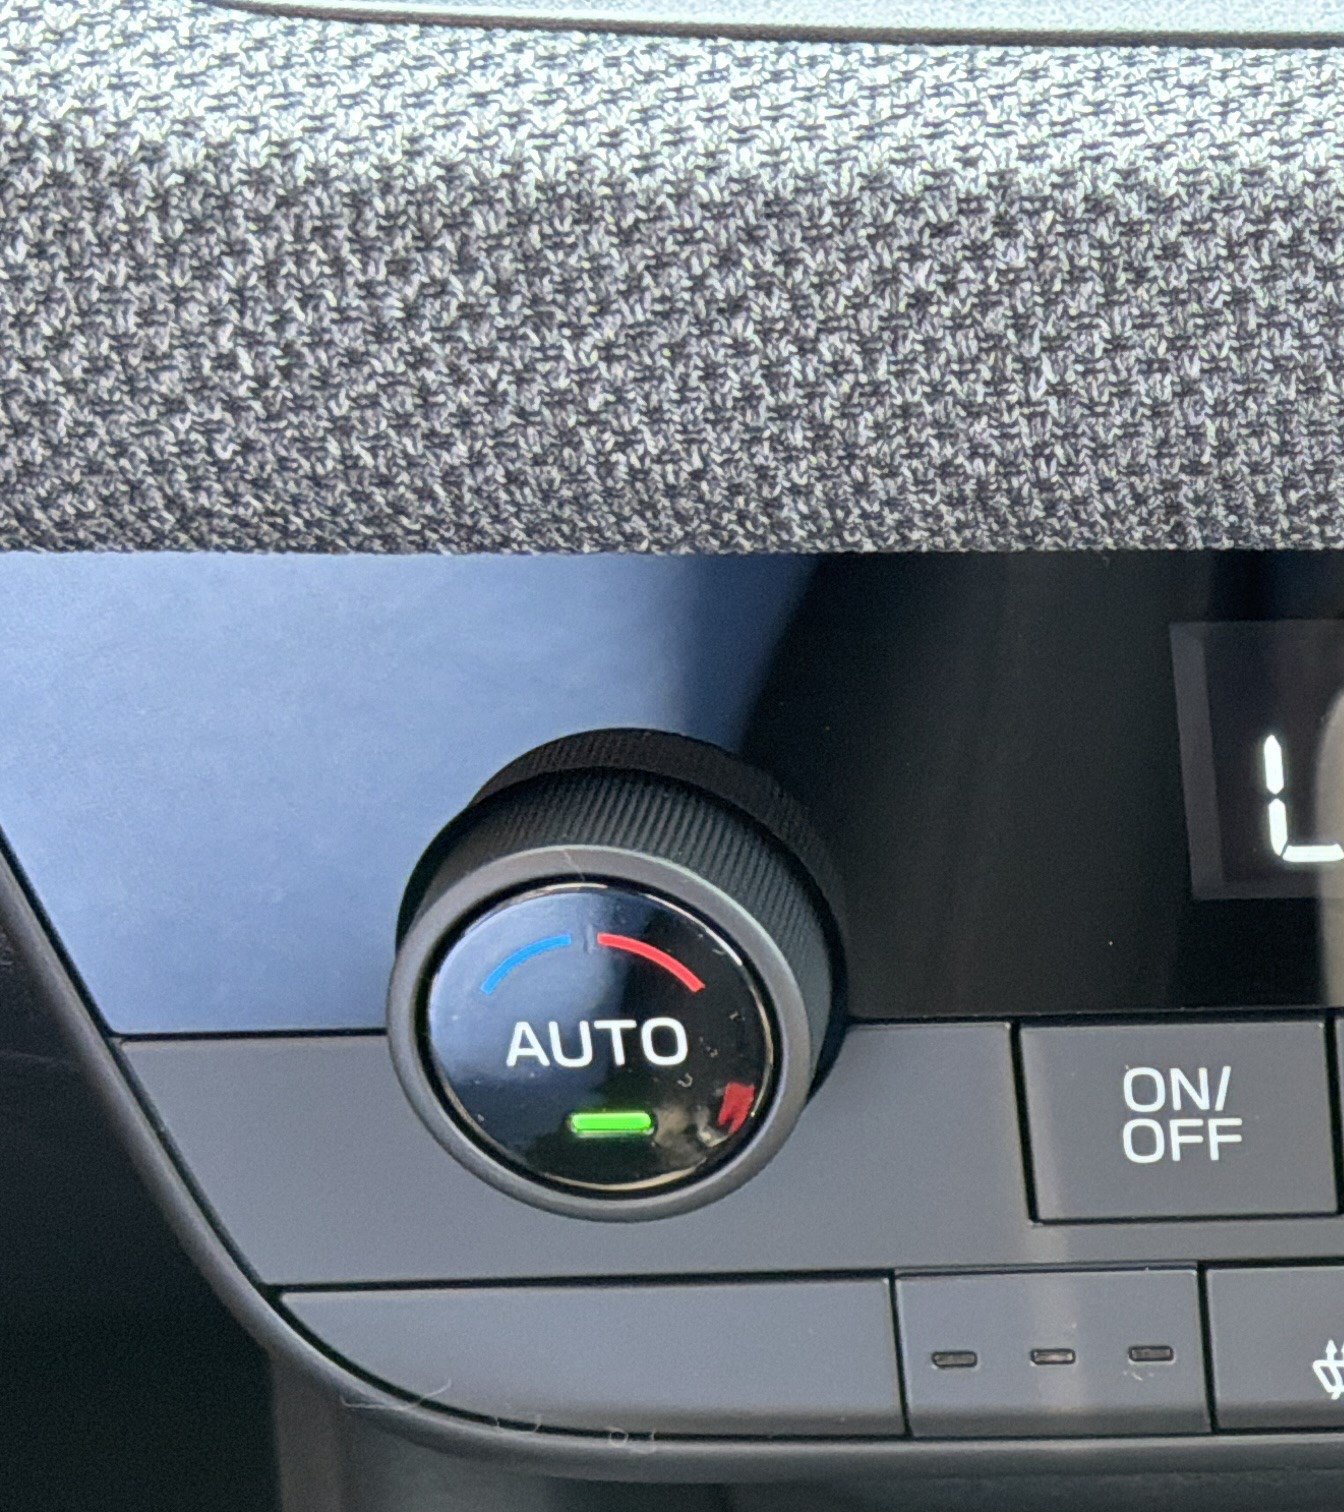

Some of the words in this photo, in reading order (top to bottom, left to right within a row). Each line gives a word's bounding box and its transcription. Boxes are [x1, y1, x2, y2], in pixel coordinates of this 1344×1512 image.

[505, 1017, 688, 1067] AUTO
[1123, 1065, 1232, 1113] ON/
[1122, 1117, 1243, 1164] OFF
